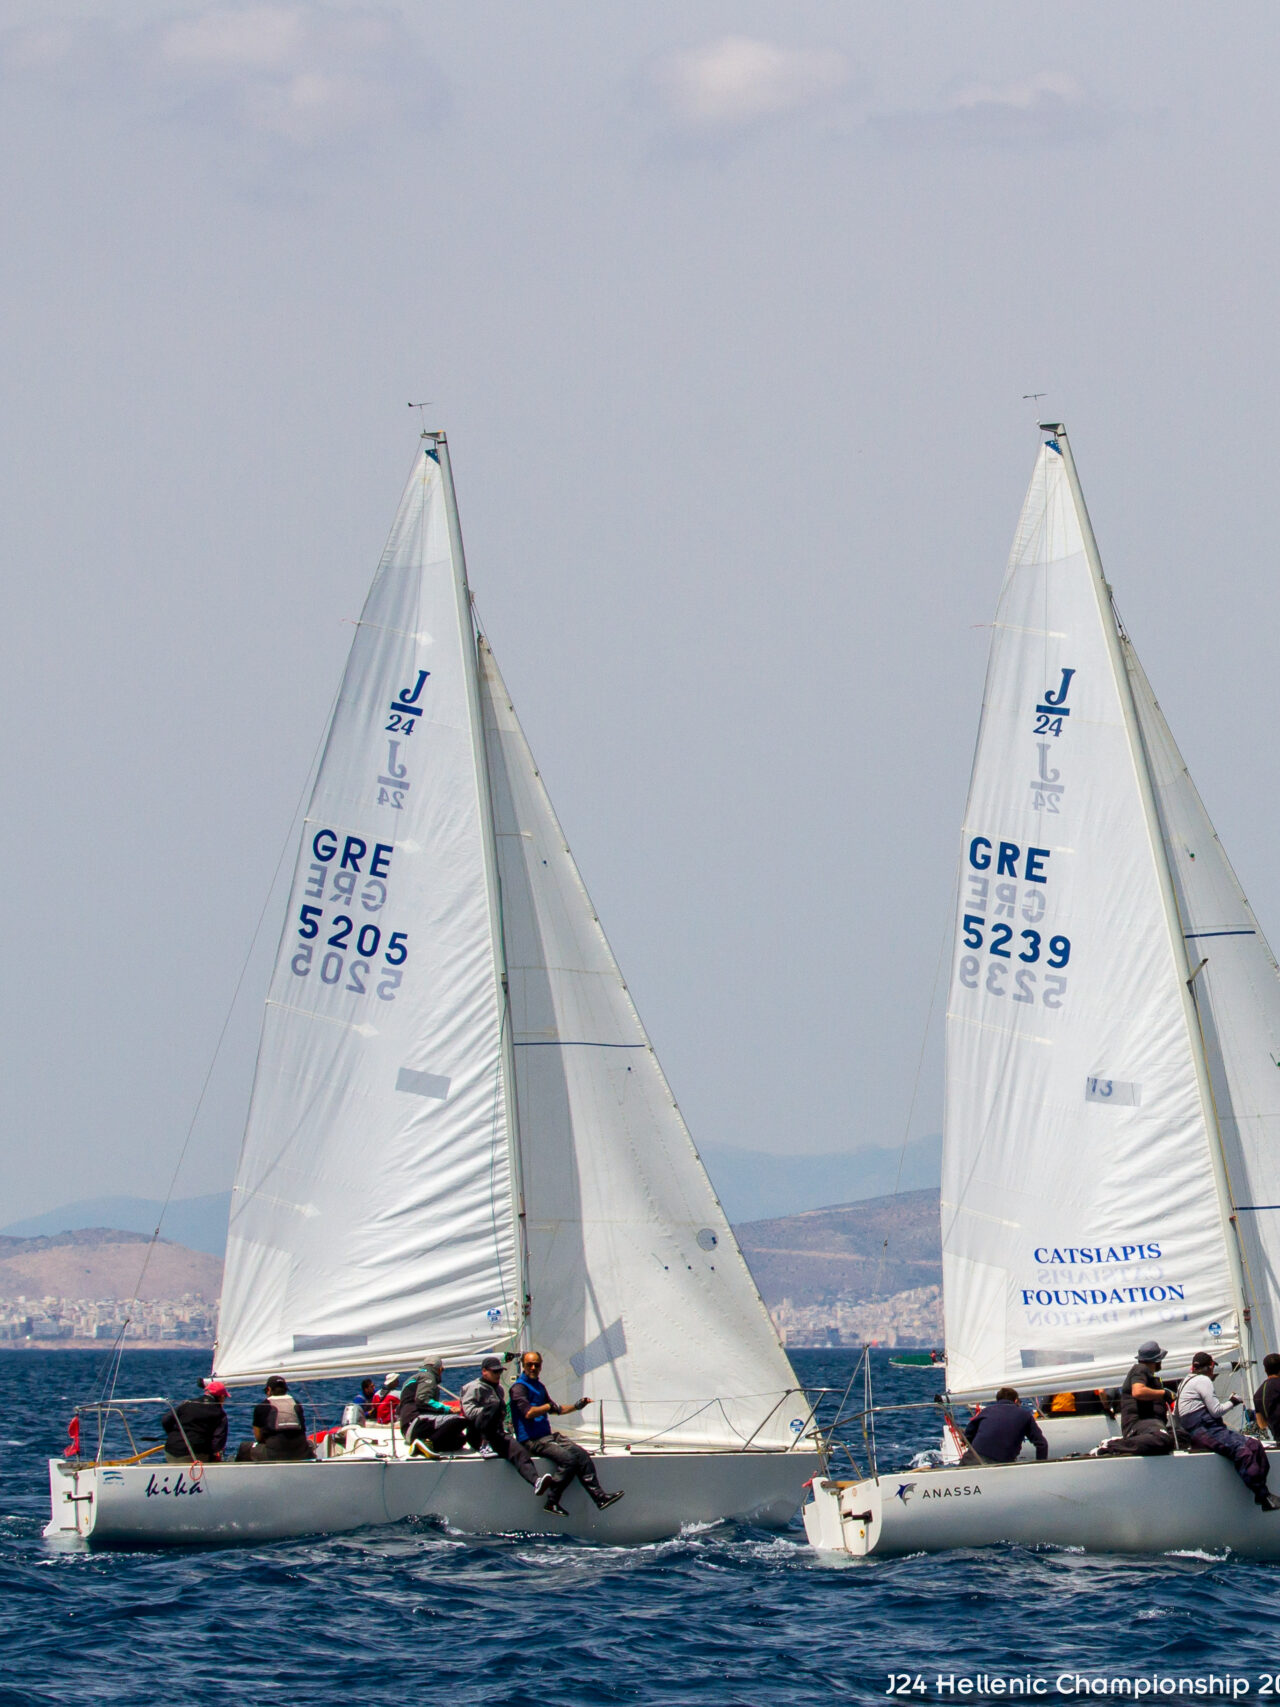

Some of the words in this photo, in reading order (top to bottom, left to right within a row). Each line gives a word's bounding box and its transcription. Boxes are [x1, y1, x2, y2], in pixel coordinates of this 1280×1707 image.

[398, 669, 431, 704] J
[1044, 668, 1076, 706] J
[385, 714, 416, 736] 24
[1033, 715, 1063, 737] 24
[312, 829, 394, 879] GRE
[969, 836, 1050, 884] GRE
[298, 904, 409, 965] 5205
[962, 914, 1072, 969] 5239
[1034, 1243, 1162, 1264] CATSIAPIS
[1021, 1284, 1185, 1306] FOUNDATION
[145, 1473, 203, 1498] kika
[922, 1485, 982, 1500] ANASSA
